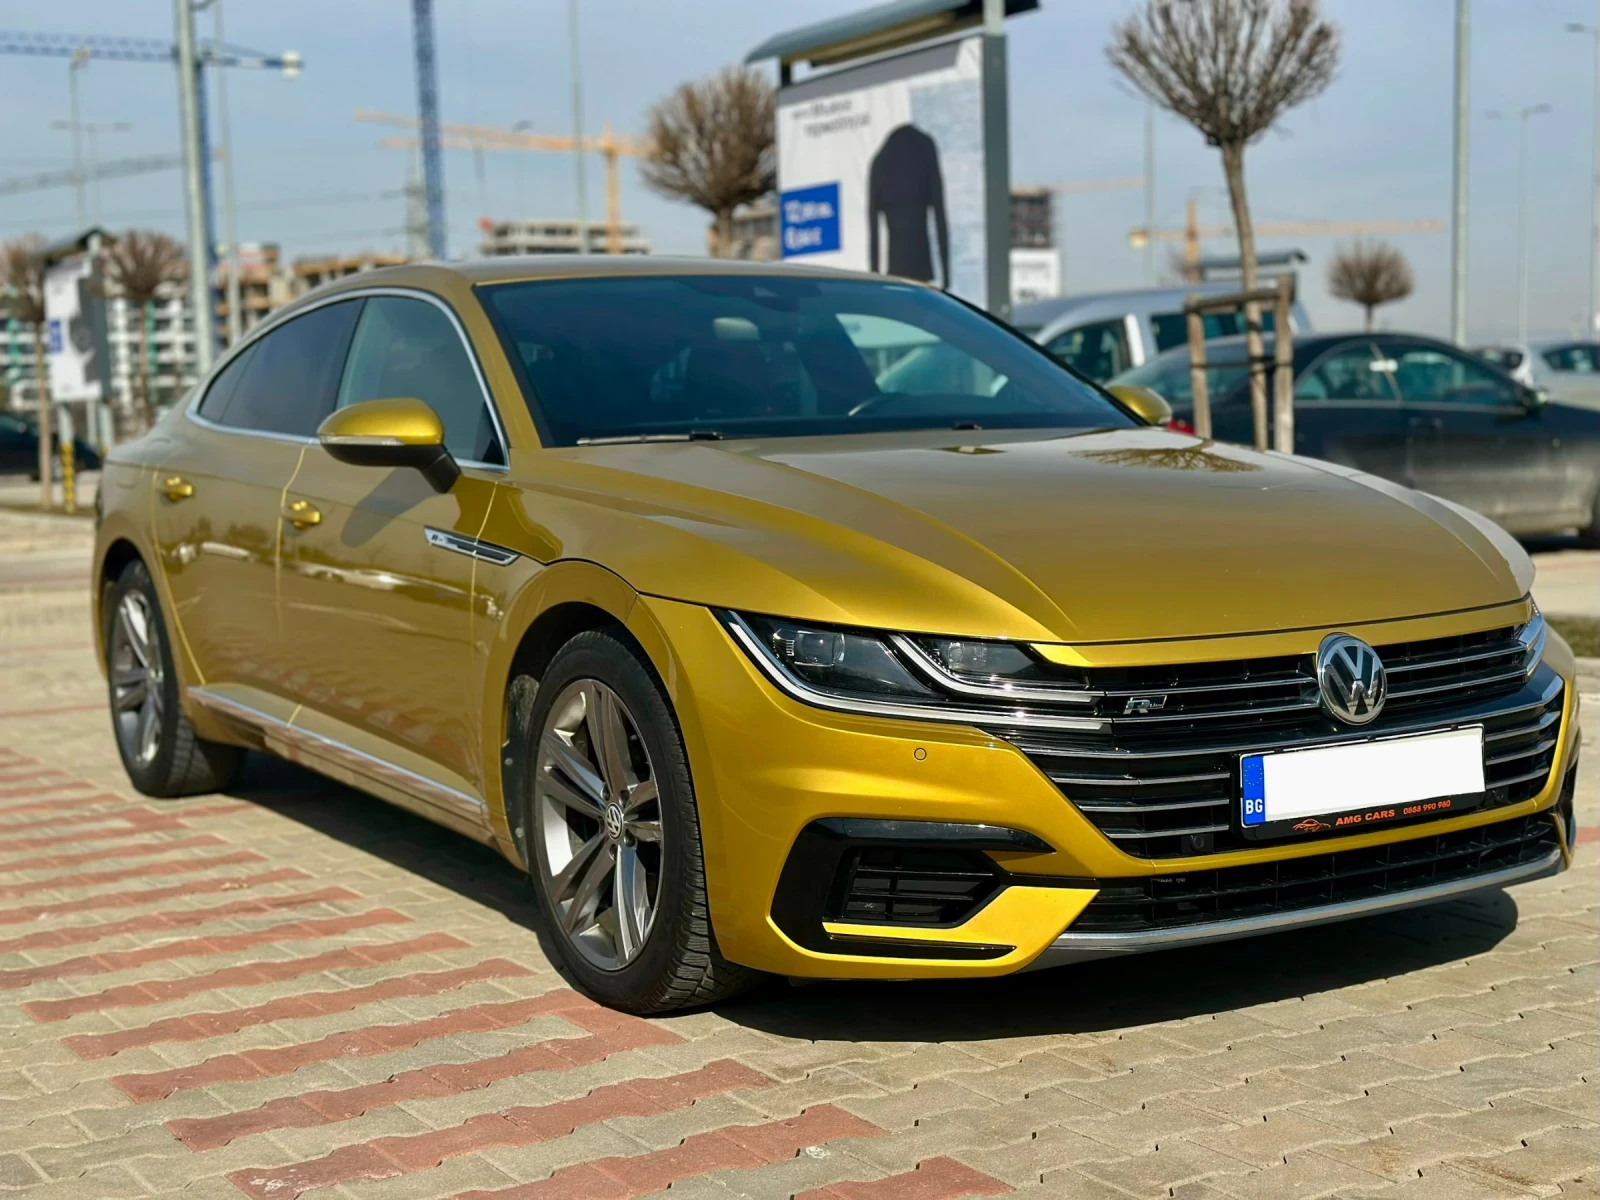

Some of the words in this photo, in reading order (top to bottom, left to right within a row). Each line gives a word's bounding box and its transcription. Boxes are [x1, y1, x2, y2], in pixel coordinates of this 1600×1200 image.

[1321, 639, 1383, 721] VW
[1245, 798, 1263, 815] BG
[1335, 814, 1362, 826] AMG
[1365, 810, 1396, 821] CARS
[1423, 802, 1437, 811] 990
